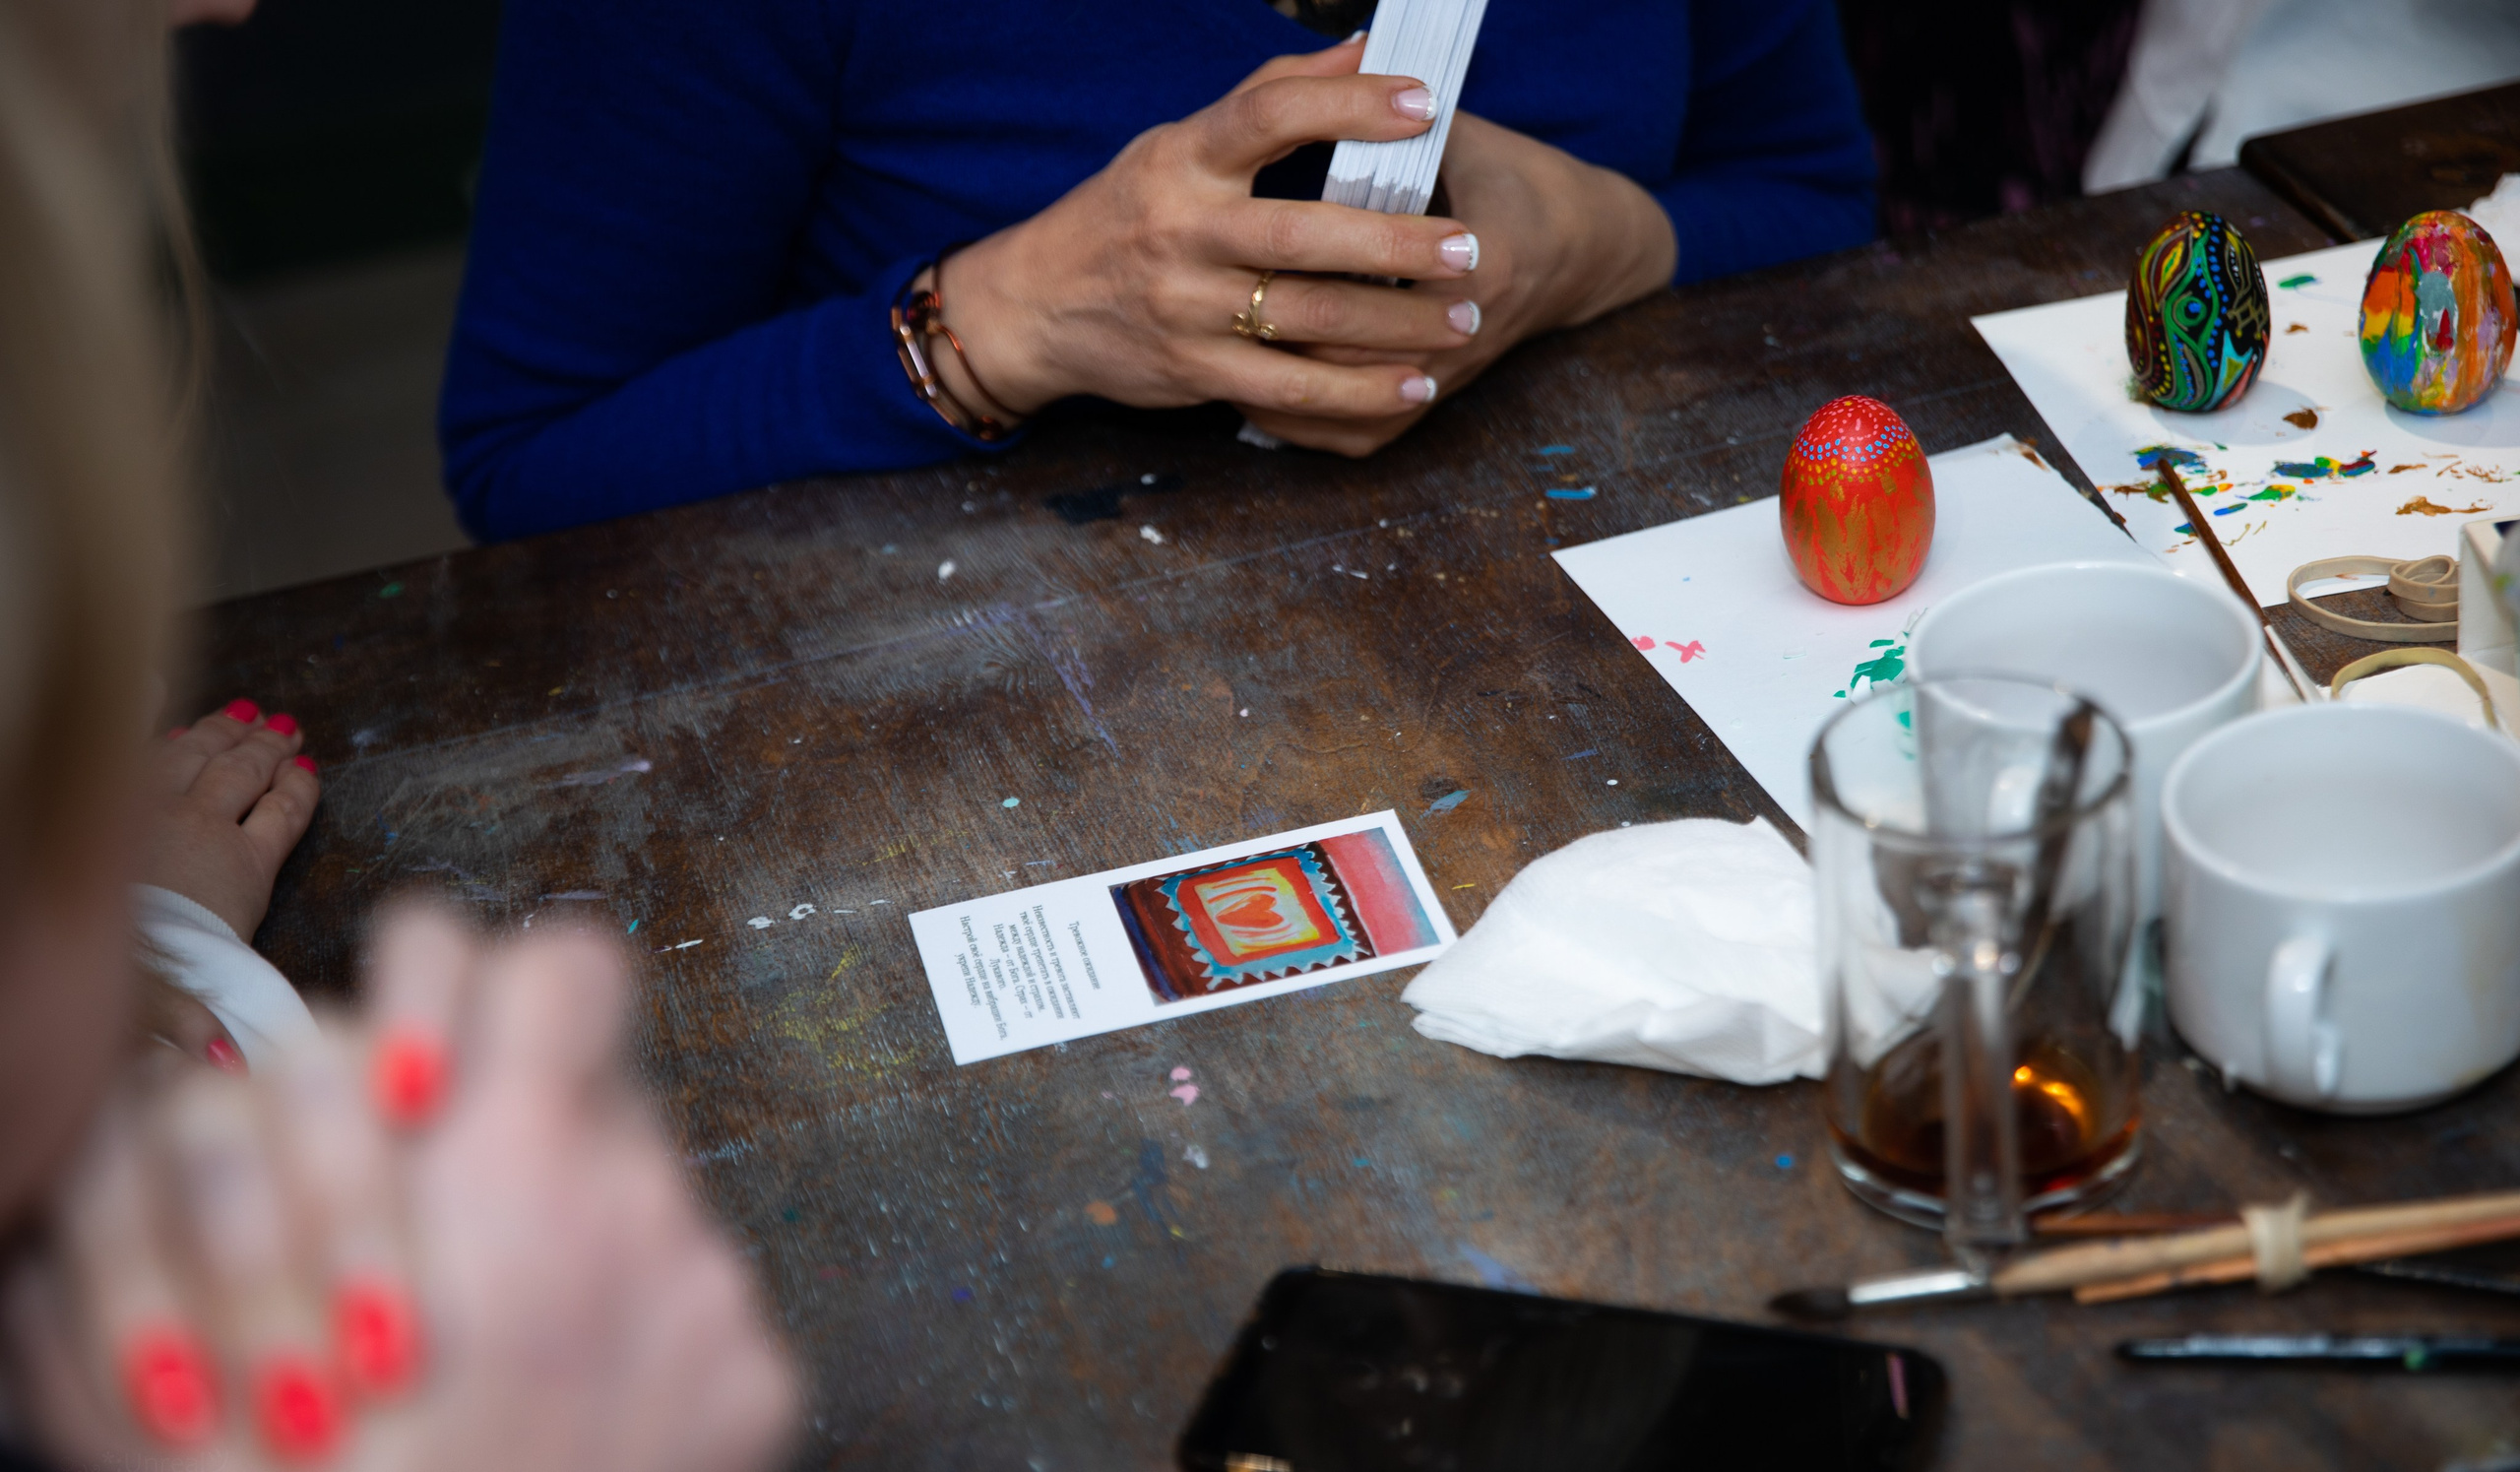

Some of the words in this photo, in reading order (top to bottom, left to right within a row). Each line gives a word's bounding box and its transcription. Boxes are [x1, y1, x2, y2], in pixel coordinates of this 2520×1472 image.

[1024, 926, 1040, 948] сердце
[973, 958, 988, 981] сердце
[992, 923, 1010, 953] Надежда
[1014, 985, 1028, 1005] Страх
[1049, 956, 1067, 983] тревога
